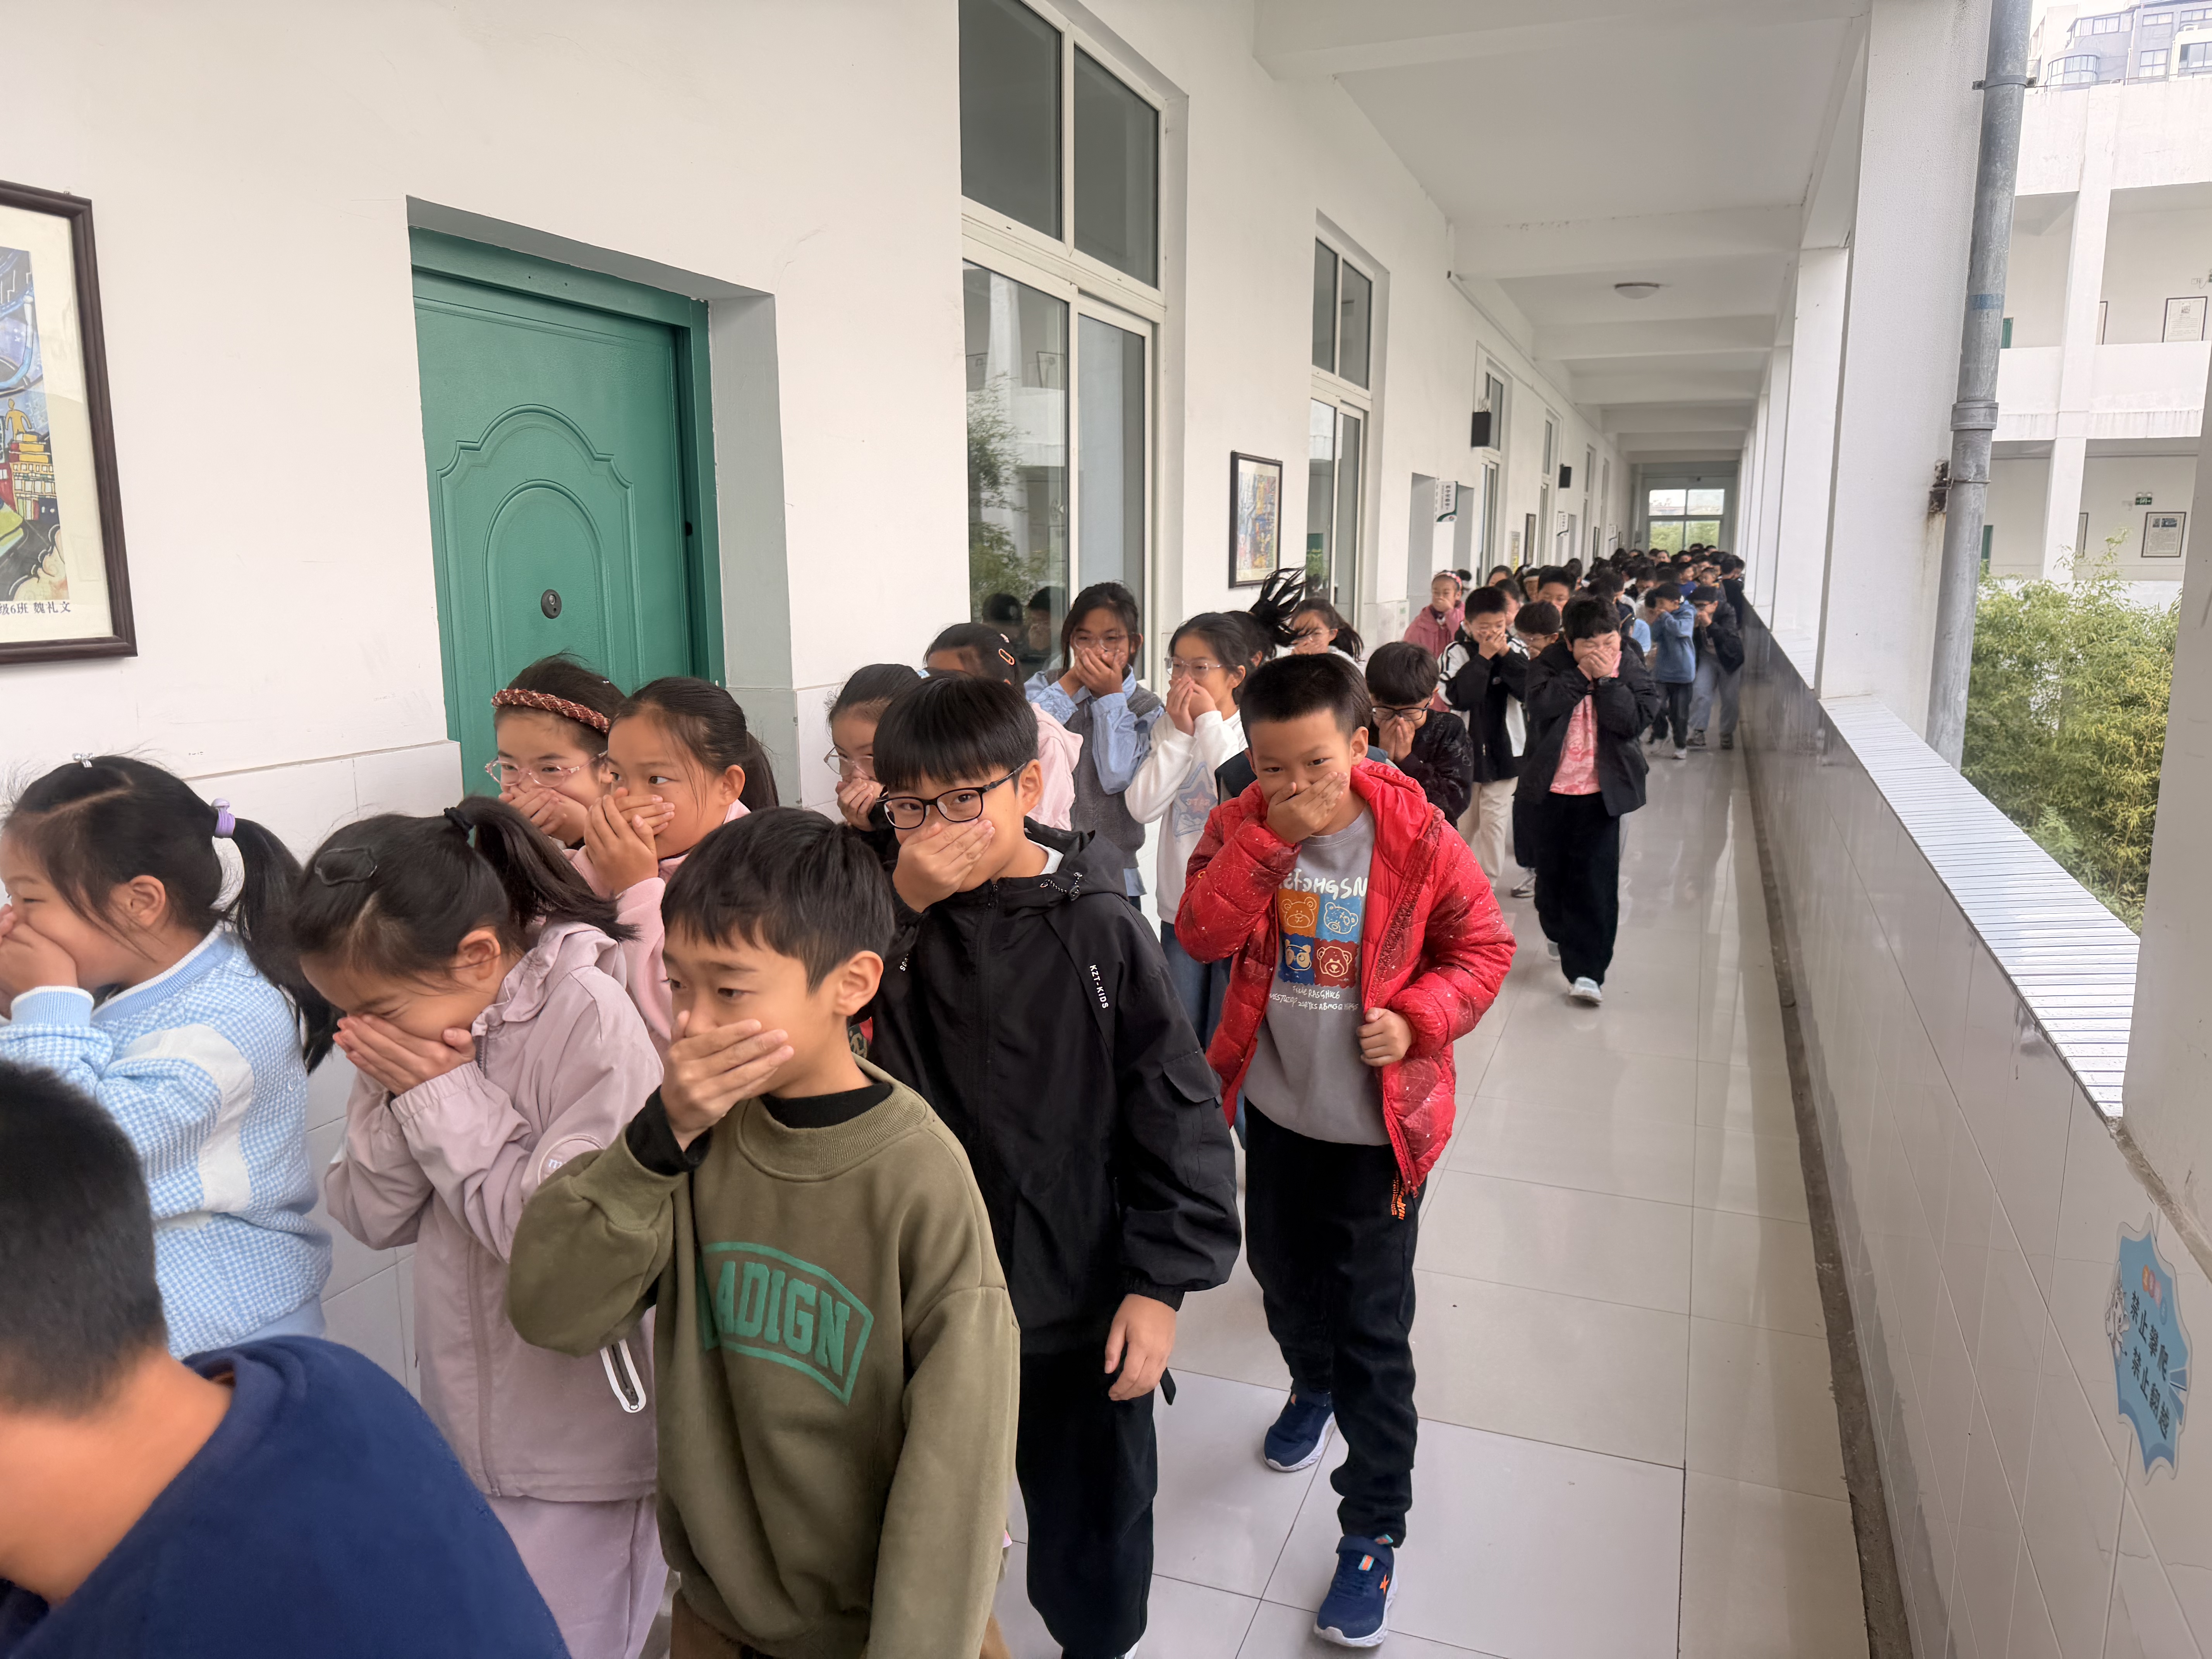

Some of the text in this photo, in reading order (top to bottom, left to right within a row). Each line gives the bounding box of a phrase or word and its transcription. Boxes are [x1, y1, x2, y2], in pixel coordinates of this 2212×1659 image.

[34, 601, 71, 614] 魏礼文
[1090, 965, 1109, 1008] KZT-KIDS
[2129, 1290, 2169, 1381] 禁止攀爬
[2131, 1346, 2169, 1440] 禁止翻越
